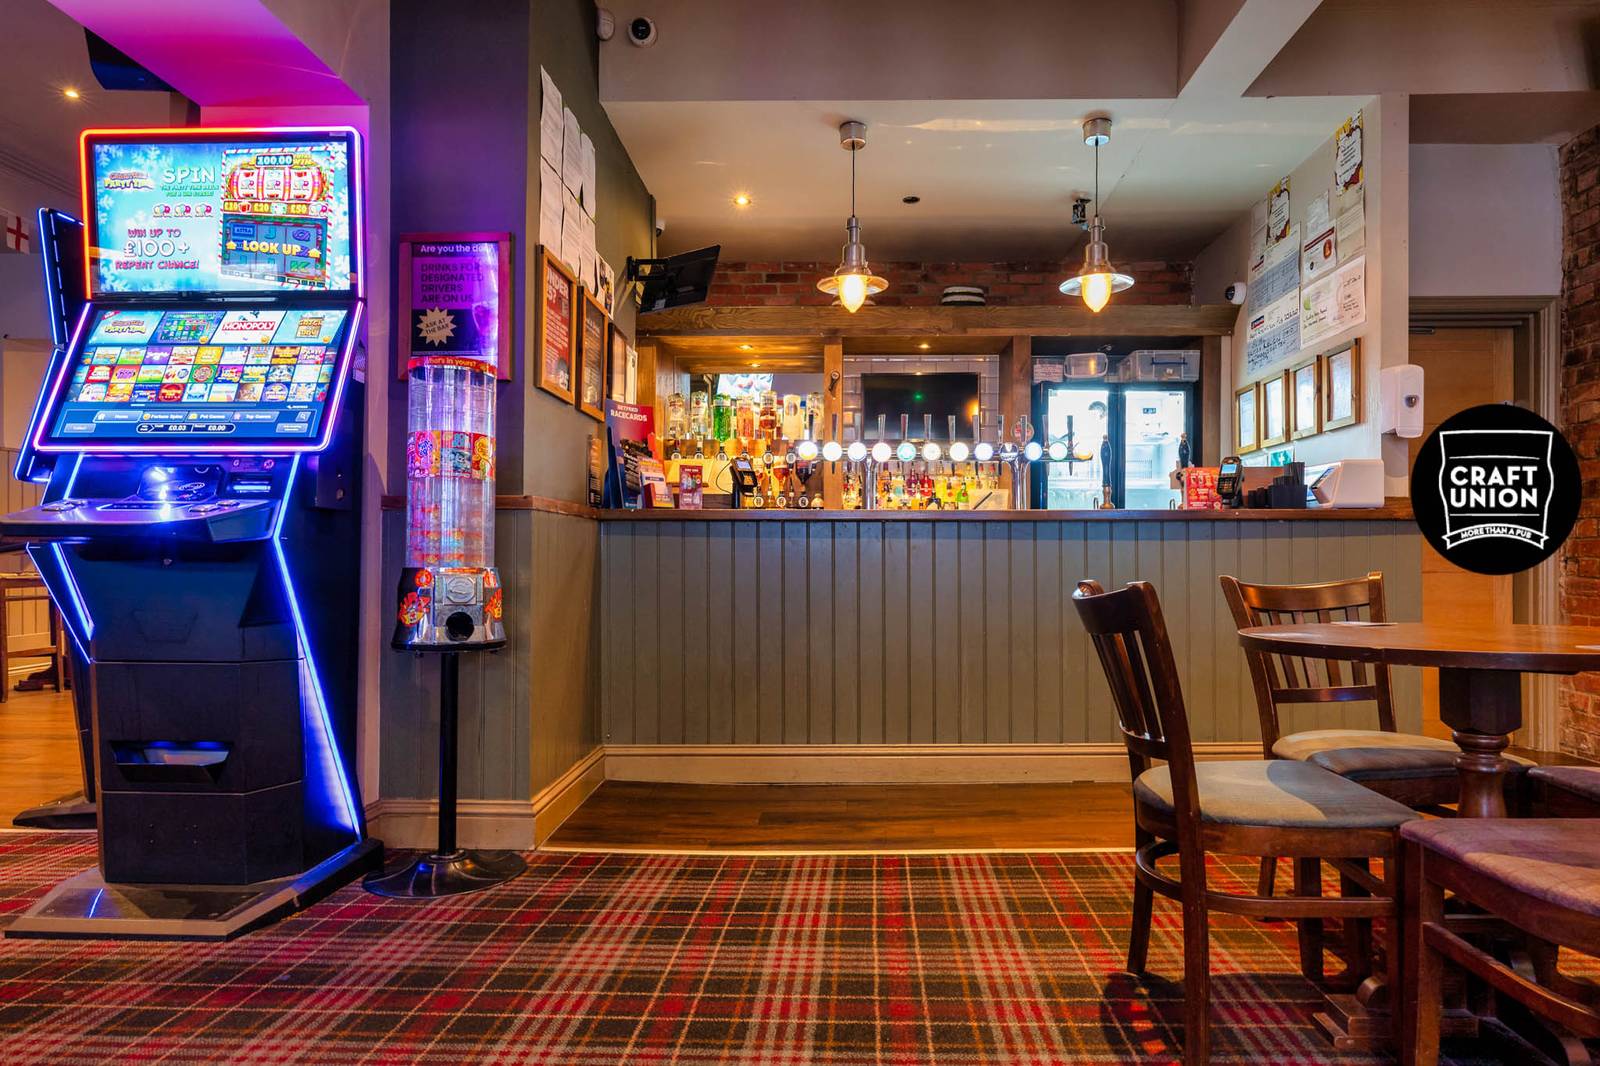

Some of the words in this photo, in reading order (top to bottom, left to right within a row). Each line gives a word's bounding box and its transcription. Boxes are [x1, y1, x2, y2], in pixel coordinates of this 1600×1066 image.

[162, 167, 216, 184] SPIN
[127, 229, 147, 238] WIN
[150, 229, 163, 238] UP
[166, 229, 182, 238] TO
[243, 240, 280, 254] LOOK
[282, 243, 302, 256] UP
[437, 246, 454, 255] you
[456, 244, 471, 252] the
[115, 260, 154, 270] REPEAT
[157, 259, 200, 270] CHANCE!
[421, 263, 458, 272] DRINKS
[460, 263, 480, 272] FOR
[421, 273, 484, 282] DESIGNATED
[421, 284, 464, 292] DRIVERS
[421, 294, 439, 303] ARE
[444, 294, 458, 303] ON
[460, 294, 474, 303] US
[223, 322, 275, 330] MONOPOLY
[425, 320, 437, 328] ASK
[437, 323, 449, 331] BAR
[454, 359, 477, 368] yours?
[610, 408, 648, 422] RACECARDS
